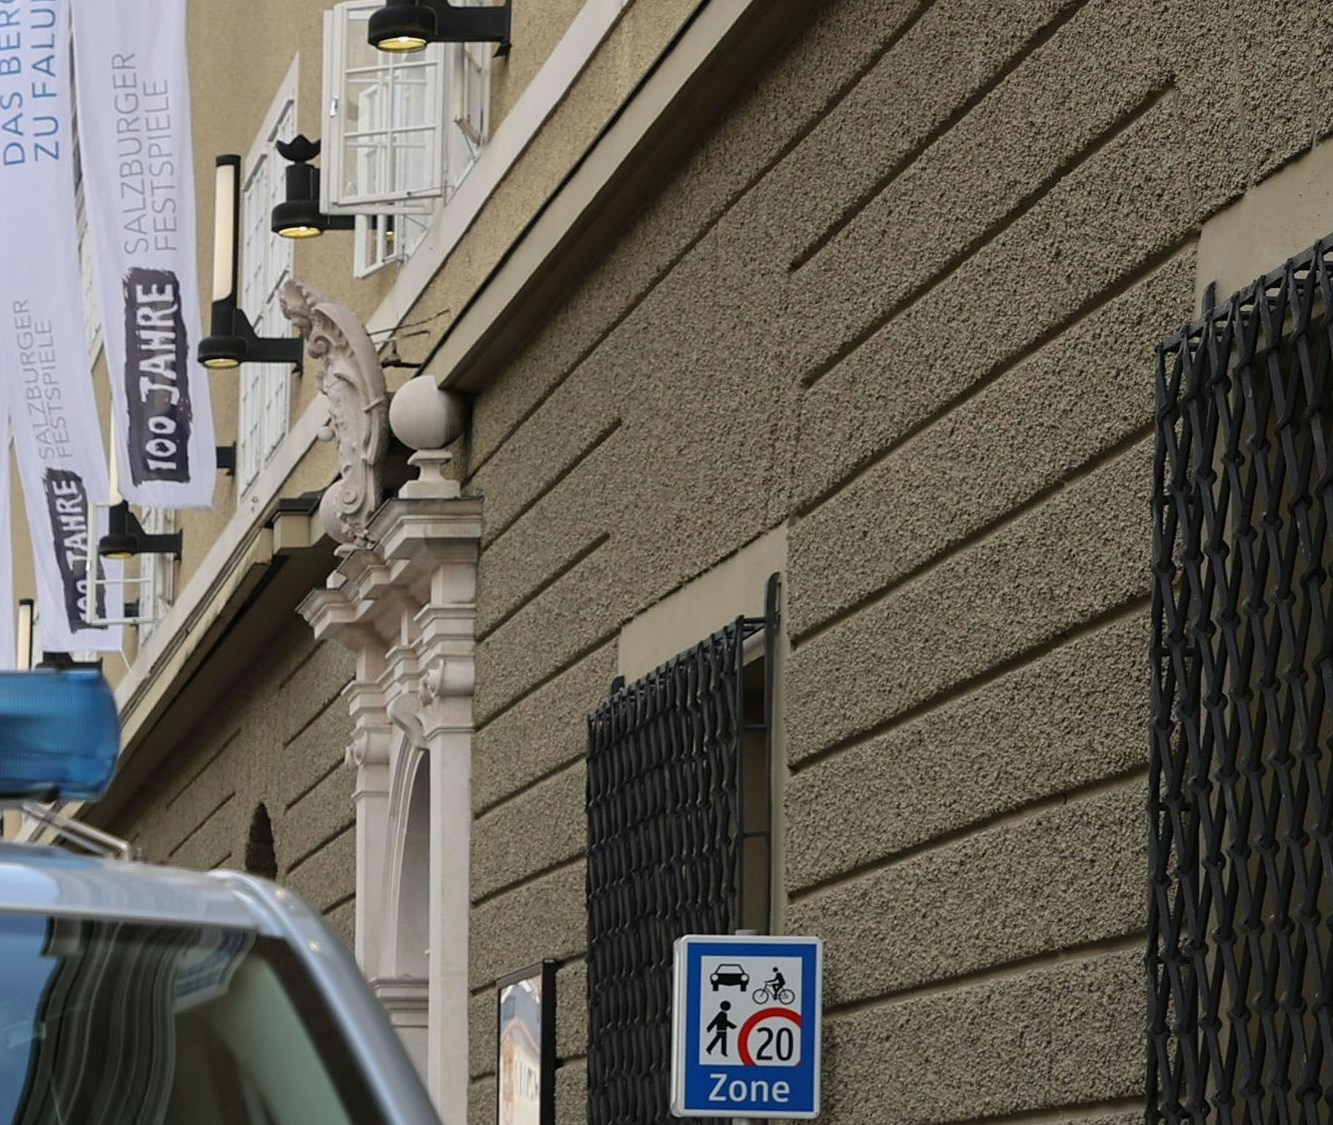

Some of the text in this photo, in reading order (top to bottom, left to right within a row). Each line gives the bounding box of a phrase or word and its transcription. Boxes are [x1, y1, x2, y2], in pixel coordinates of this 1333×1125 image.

[0, 91, 25, 165] DAS
[30, 0, 60, 161] ZU FALU
[111, 52, 150, 256] SALZBURGER
[142, 78, 178, 252] FESTSPIELE
[13, 299, 55, 459] SALZBURGER
[34, 320, 73, 459] FESTSPIELE
[135, 283, 181, 472] 100 JAHRE
[708, 1073, 790, 1103] Zone
[755, 1026, 794, 1062] 20
